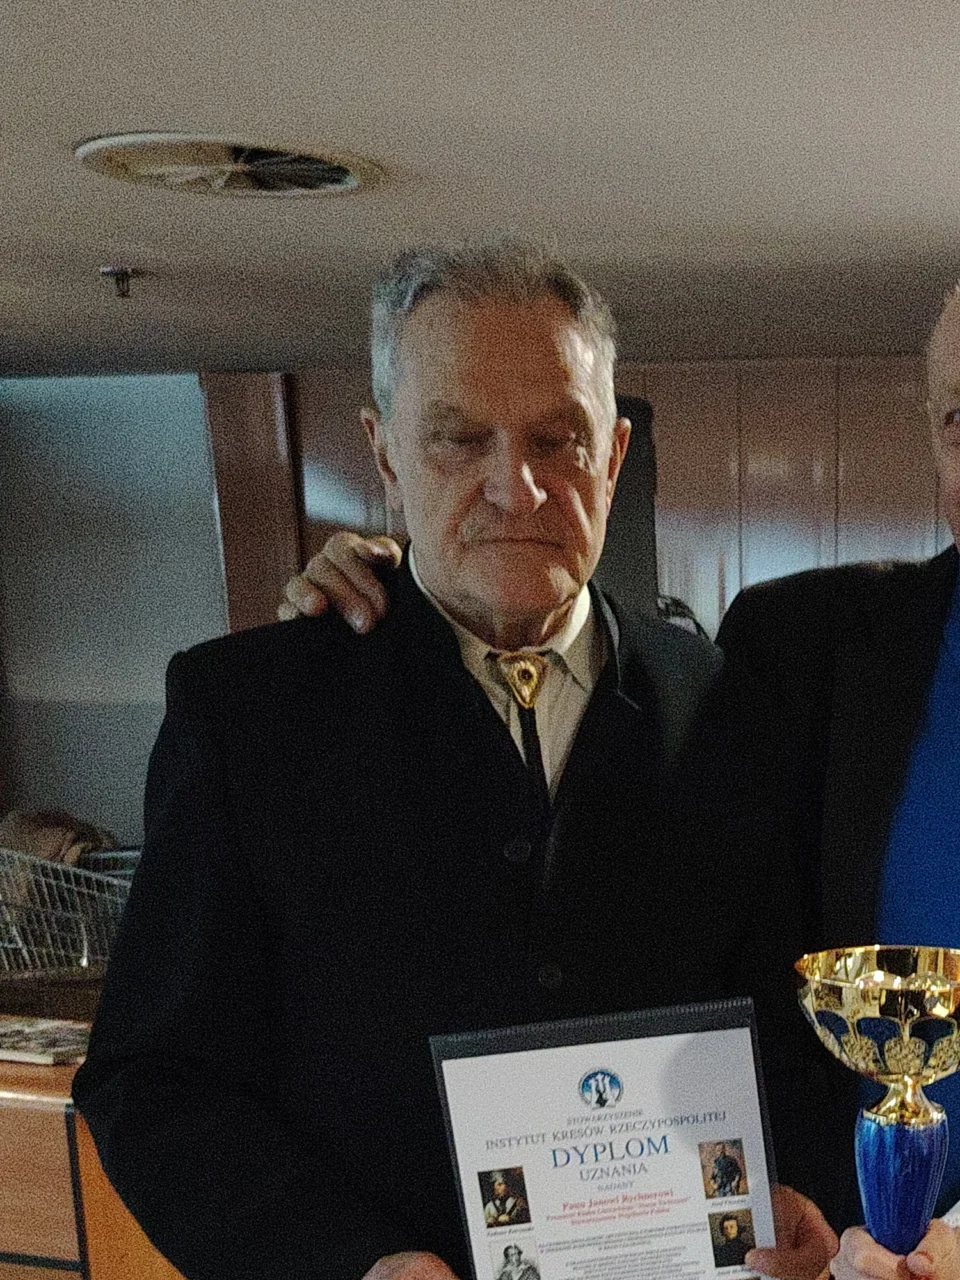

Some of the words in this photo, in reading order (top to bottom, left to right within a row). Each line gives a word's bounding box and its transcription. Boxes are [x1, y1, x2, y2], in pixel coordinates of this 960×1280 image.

[485, 1133, 547, 1149] INSTYTUT
[552, 1124, 604, 1142] KRESÓW
[609, 1111, 727, 1135] RZECZYPOSPOLITEJ
[552, 1135, 671, 1168] DYPLOM
[579, 1162, 648, 1181] UZNANIA
